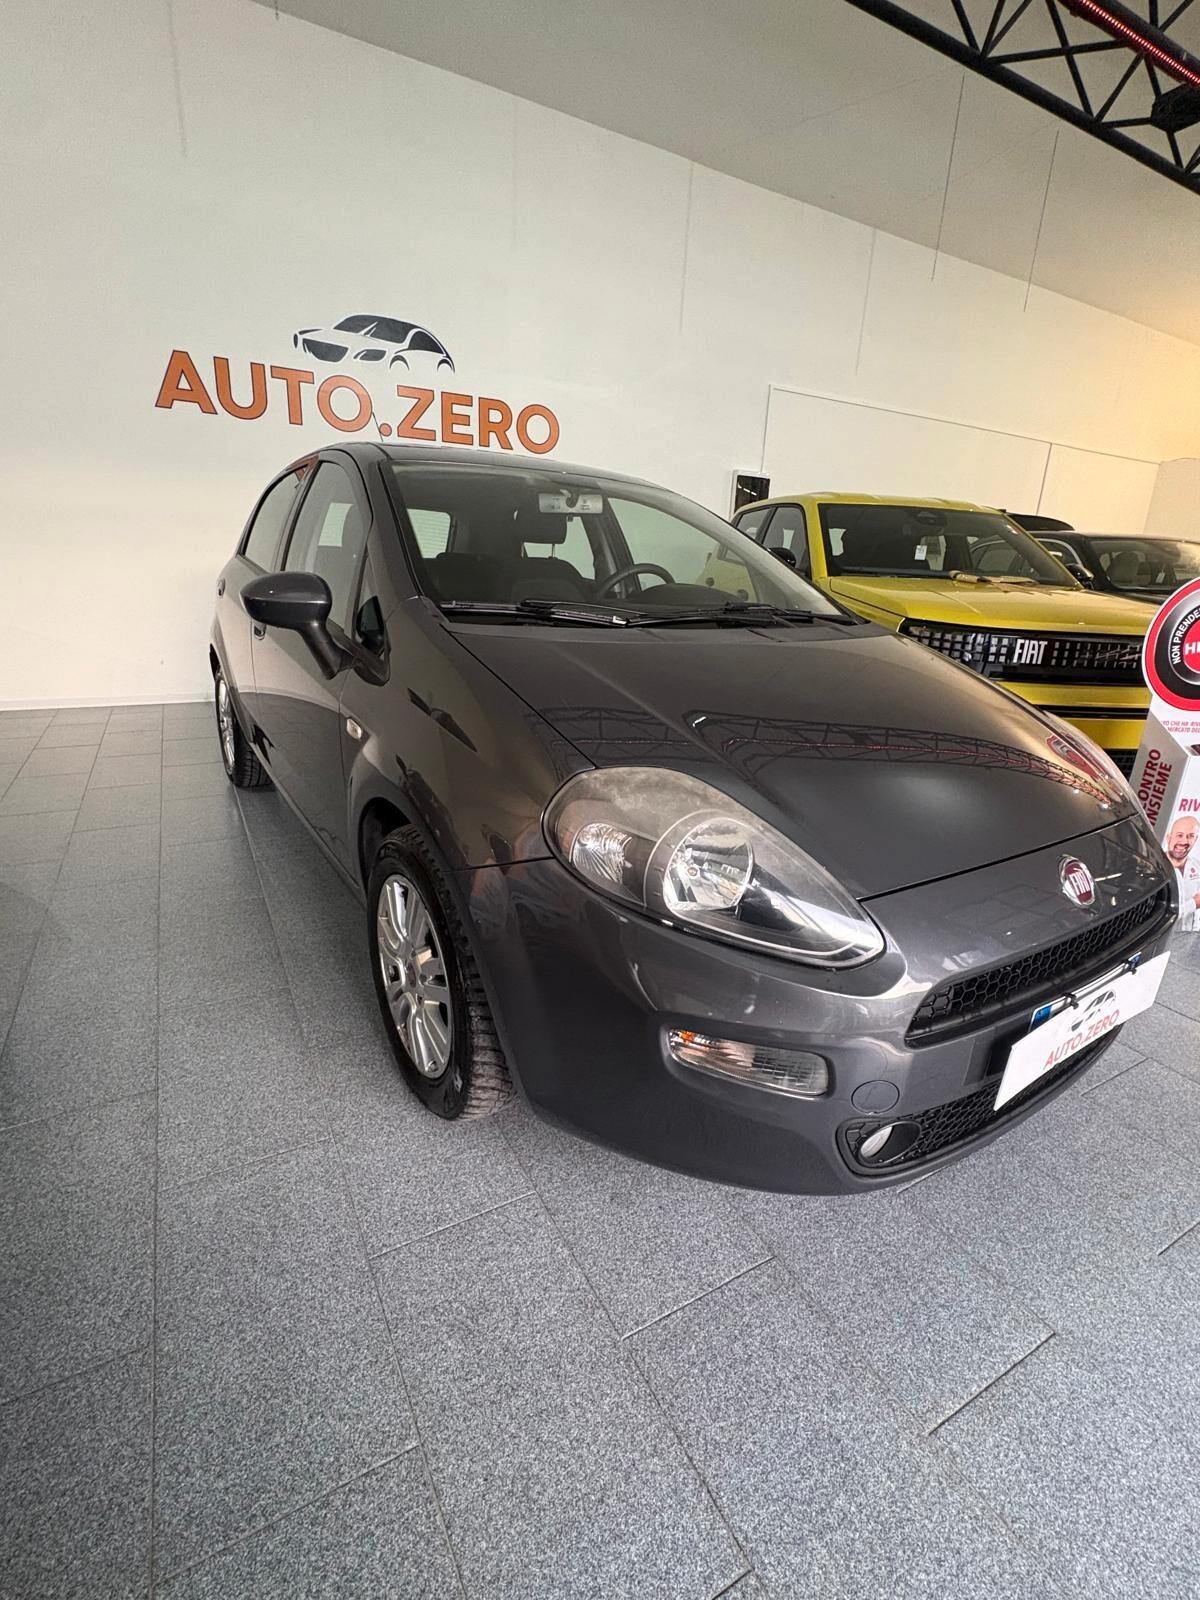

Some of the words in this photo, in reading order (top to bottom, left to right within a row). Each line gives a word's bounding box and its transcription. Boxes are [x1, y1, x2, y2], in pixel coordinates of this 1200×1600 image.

[155, 350, 560, 455] AUTO.ZERO
[1173, 607, 1200, 643] PRENDE
[1013, 639, 1048, 665] FIAT
[1171, 642, 1182, 665] NON
[1137, 749, 1161, 811] ONTRO
[1067, 867, 1091, 896] FIAT
[1043, 1009, 1120, 1070] AUTO.ZERO
